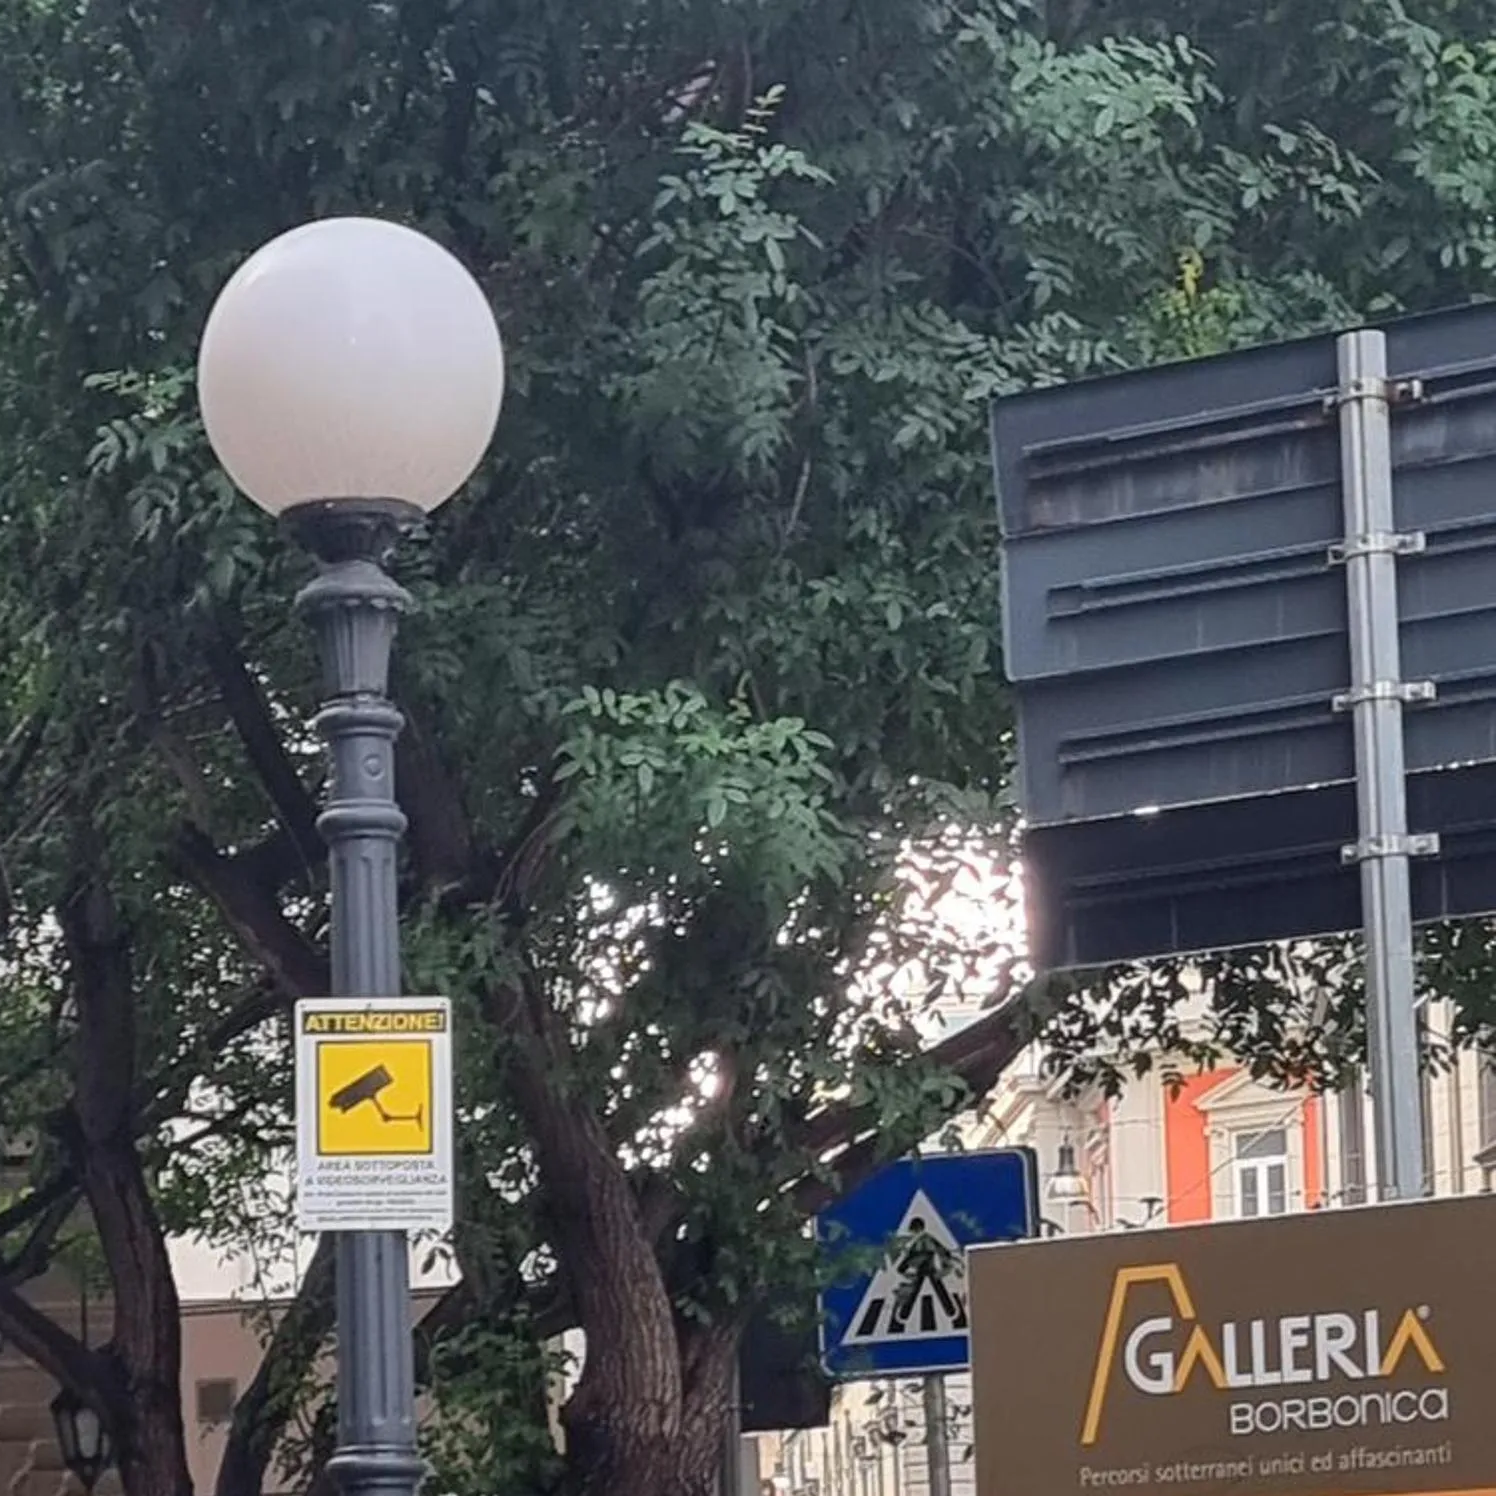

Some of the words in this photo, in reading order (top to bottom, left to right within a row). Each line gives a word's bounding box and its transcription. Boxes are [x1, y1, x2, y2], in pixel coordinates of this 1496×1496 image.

[306, 1012, 444, 1032] ATTENZIONE!
[1124, 1307, 1445, 1394] GALLERIA
[1079, 1462, 1150, 1488] Percorsi
[1155, 1454, 1254, 1483] sotterranei
[1259, 1452, 1304, 1476] unici
[1310, 1452, 1333, 1472] ed
[1338, 1440, 1452, 1470] affascinanti
